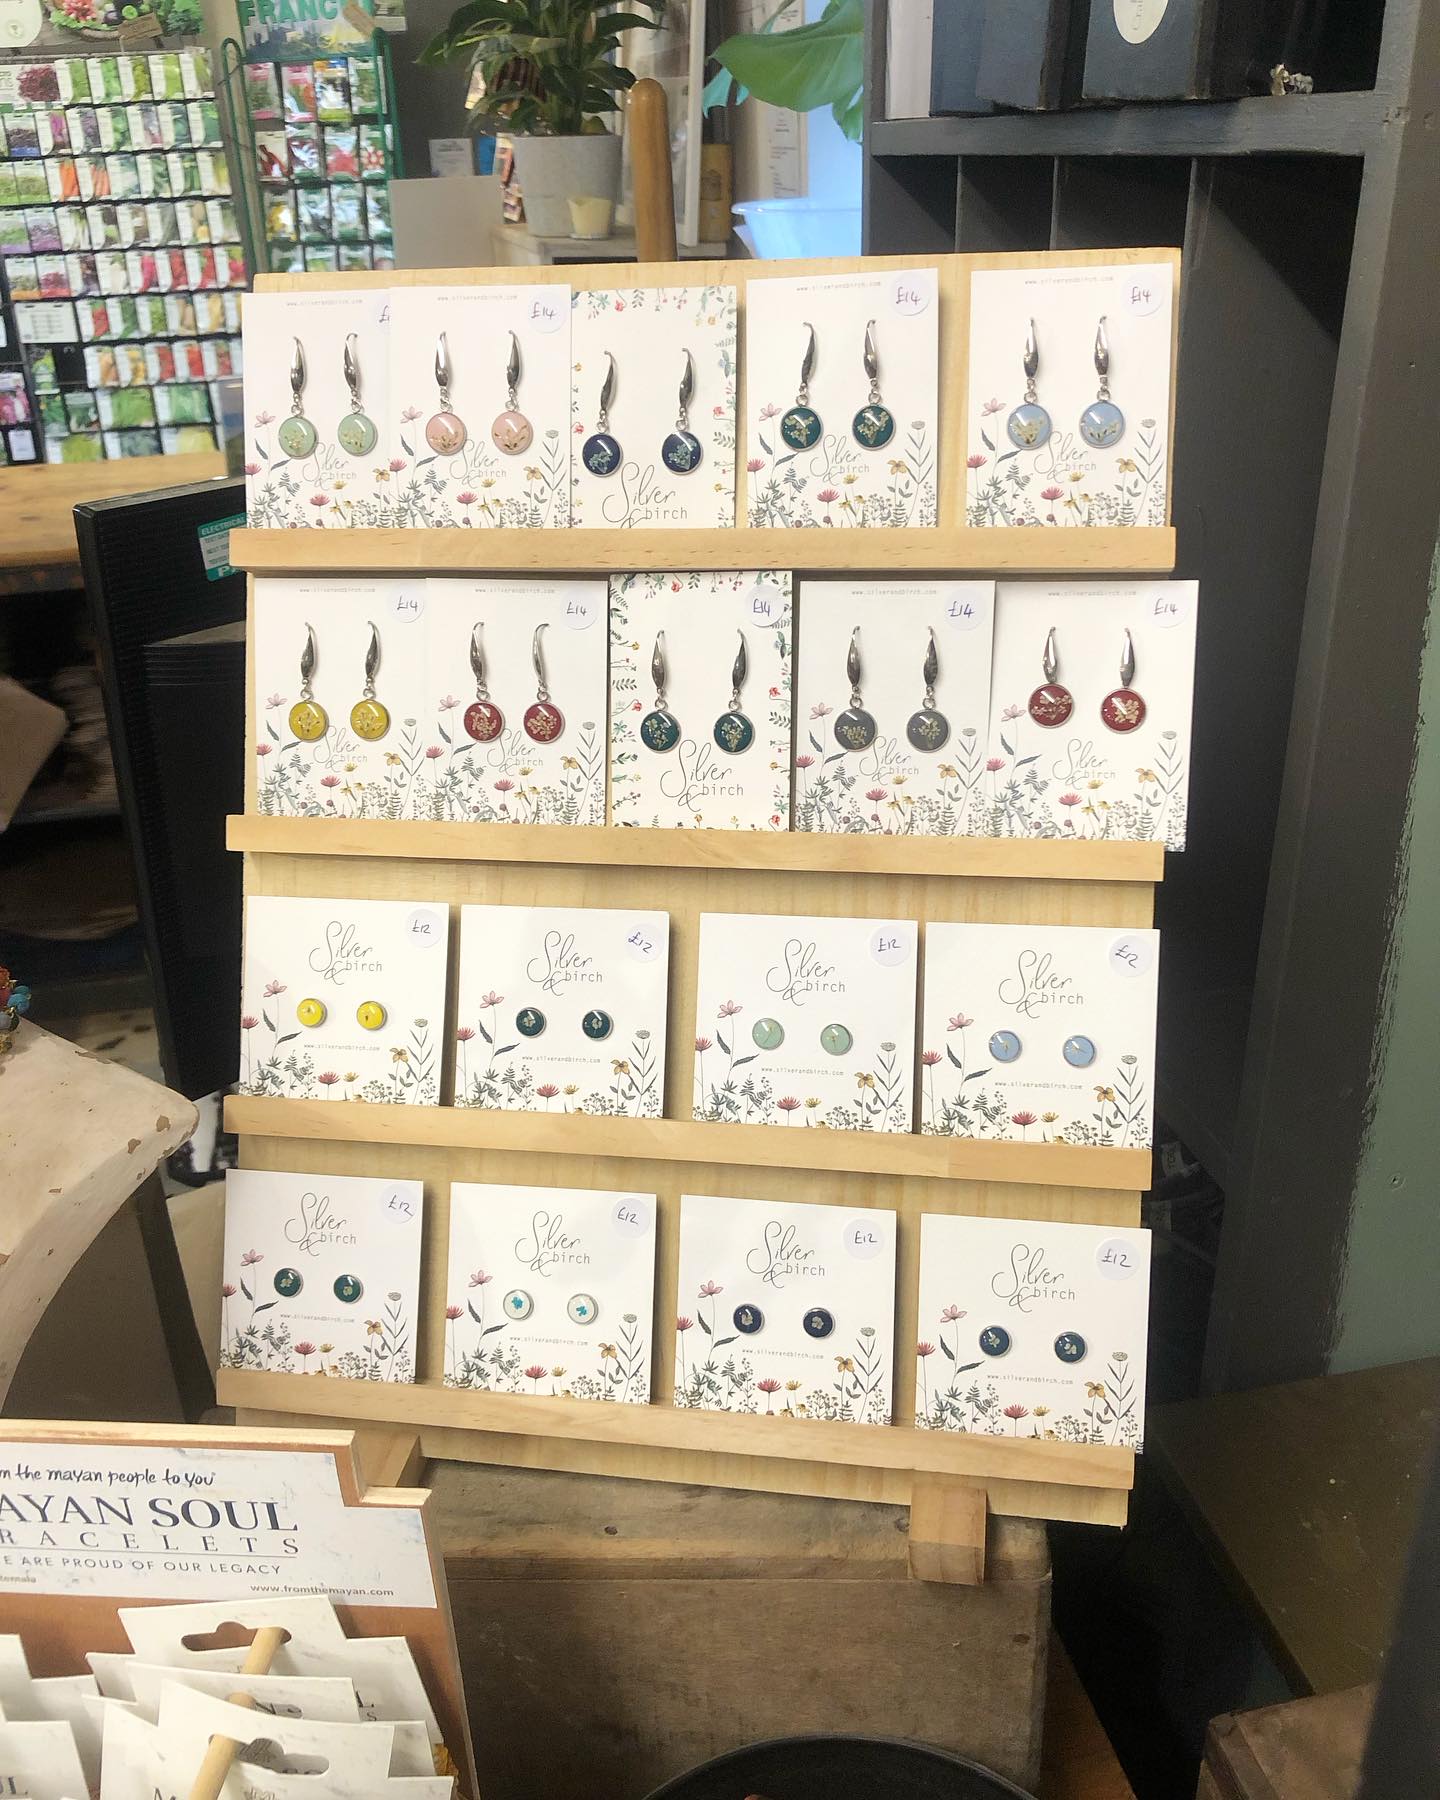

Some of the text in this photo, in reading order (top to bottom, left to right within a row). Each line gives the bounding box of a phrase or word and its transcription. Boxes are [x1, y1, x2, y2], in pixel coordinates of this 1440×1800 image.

[302, 441, 349, 482] Silver
[449, 438, 500, 480] Silver
[809, 434, 862, 478] Silver
[1033, 431, 1089, 474] Silver
[329, 471, 357, 480] birch
[478, 469, 507, 478] birch
[838, 462, 870, 474] birch
[1064, 460, 1097, 472] birch
[602, 461, 676, 523] Silver
[644, 506, 688, 521] birch
[313, 725, 360, 763] Silver
[486, 728, 536, 768] Silver
[859, 734, 913, 777] Silver
[338, 752, 368, 763] birch
[515, 755, 544, 767] birch
[659, 739, 734, 798] Silver
[1052, 738, 1109, 781] Silver
[888, 764, 920, 776] birch
[1084, 768, 1116, 780] birch
[700, 783, 744, 797] birch
[308, 920, 374, 974] Silver
[526, 930, 593, 984] Silver
[345, 959, 383, 973] birch
[563, 970, 603, 984] birch
[765, 938, 836, 994] Silver
[998, 949, 1073, 1005] Silver
[805, 978, 846, 993] birch
[1041, 991, 1085, 1005] birch
[284, 1192, 348, 1244] Silver
[319, 1231, 357, 1246] birch
[514, 1210, 581, 1263] Silver
[745, 1220, 816, 1274] Silver
[551, 1250, 591, 1265] birch
[784, 1262, 826, 1277] birch
[991, 1243, 1065, 1299] Silver
[1033, 1286, 1076, 1301] birch
[15, 1463, 41, 1482] the
[48, 1469, 103, 1483] mayan
[108, 1467, 156, 1487] people
[162, 1468, 181, 1484] to
[0, 1493, 299, 1532] AYAN SOUL
[0, 1528, 299, 1555] RACELETS
[21, 1555, 54, 1567] ARE
[62, 1558, 123, 1569] PROUD
[132, 1560, 155, 1571] OF
[164, 1562, 202, 1573] OUR
[210, 1564, 281, 1575] LEGACY
[250, 1583, 394, 1598] www.fromthemayan.com
